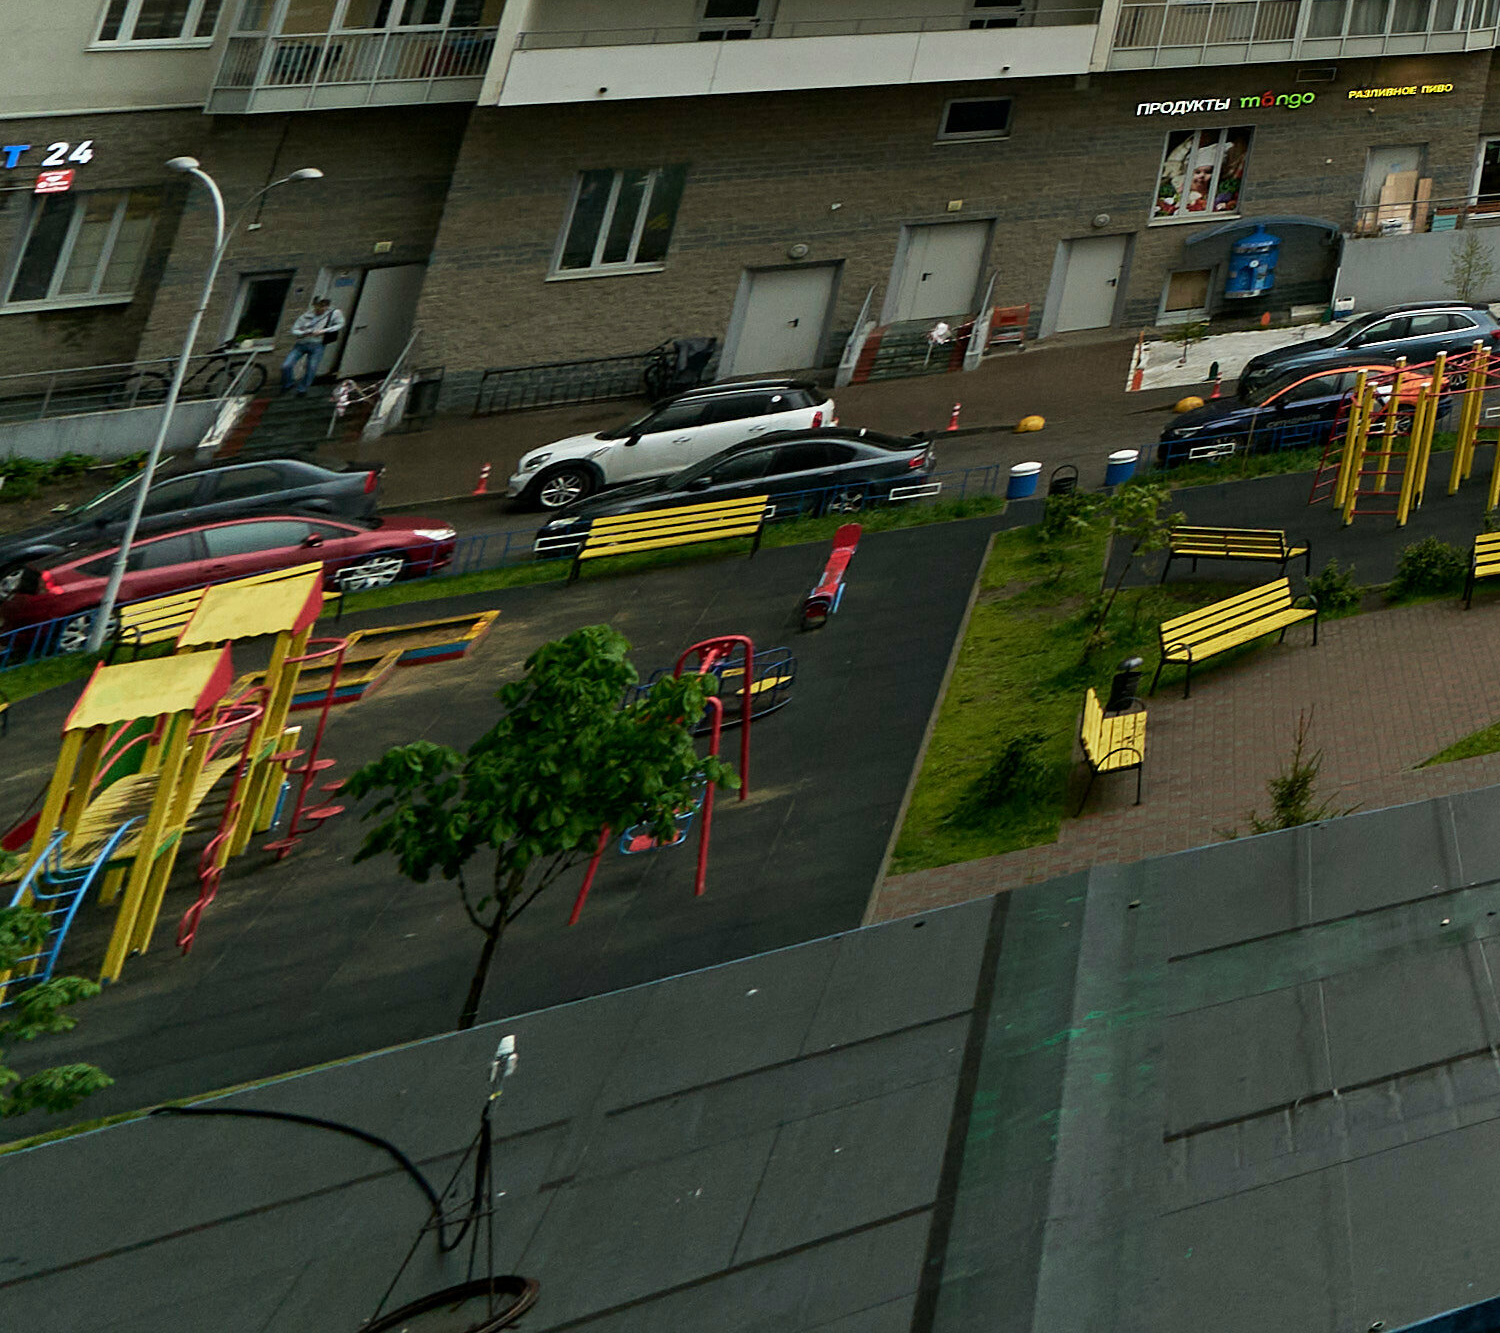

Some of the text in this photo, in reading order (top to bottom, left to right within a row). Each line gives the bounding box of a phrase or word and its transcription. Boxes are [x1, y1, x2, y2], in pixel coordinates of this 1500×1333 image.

[1348, 83, 1454, 99] РАЗЛИВНОЕ ПИВО
[1136, 98, 1231, 116] ПРОДУКТЫ
[41, 140, 94, 167] 24
